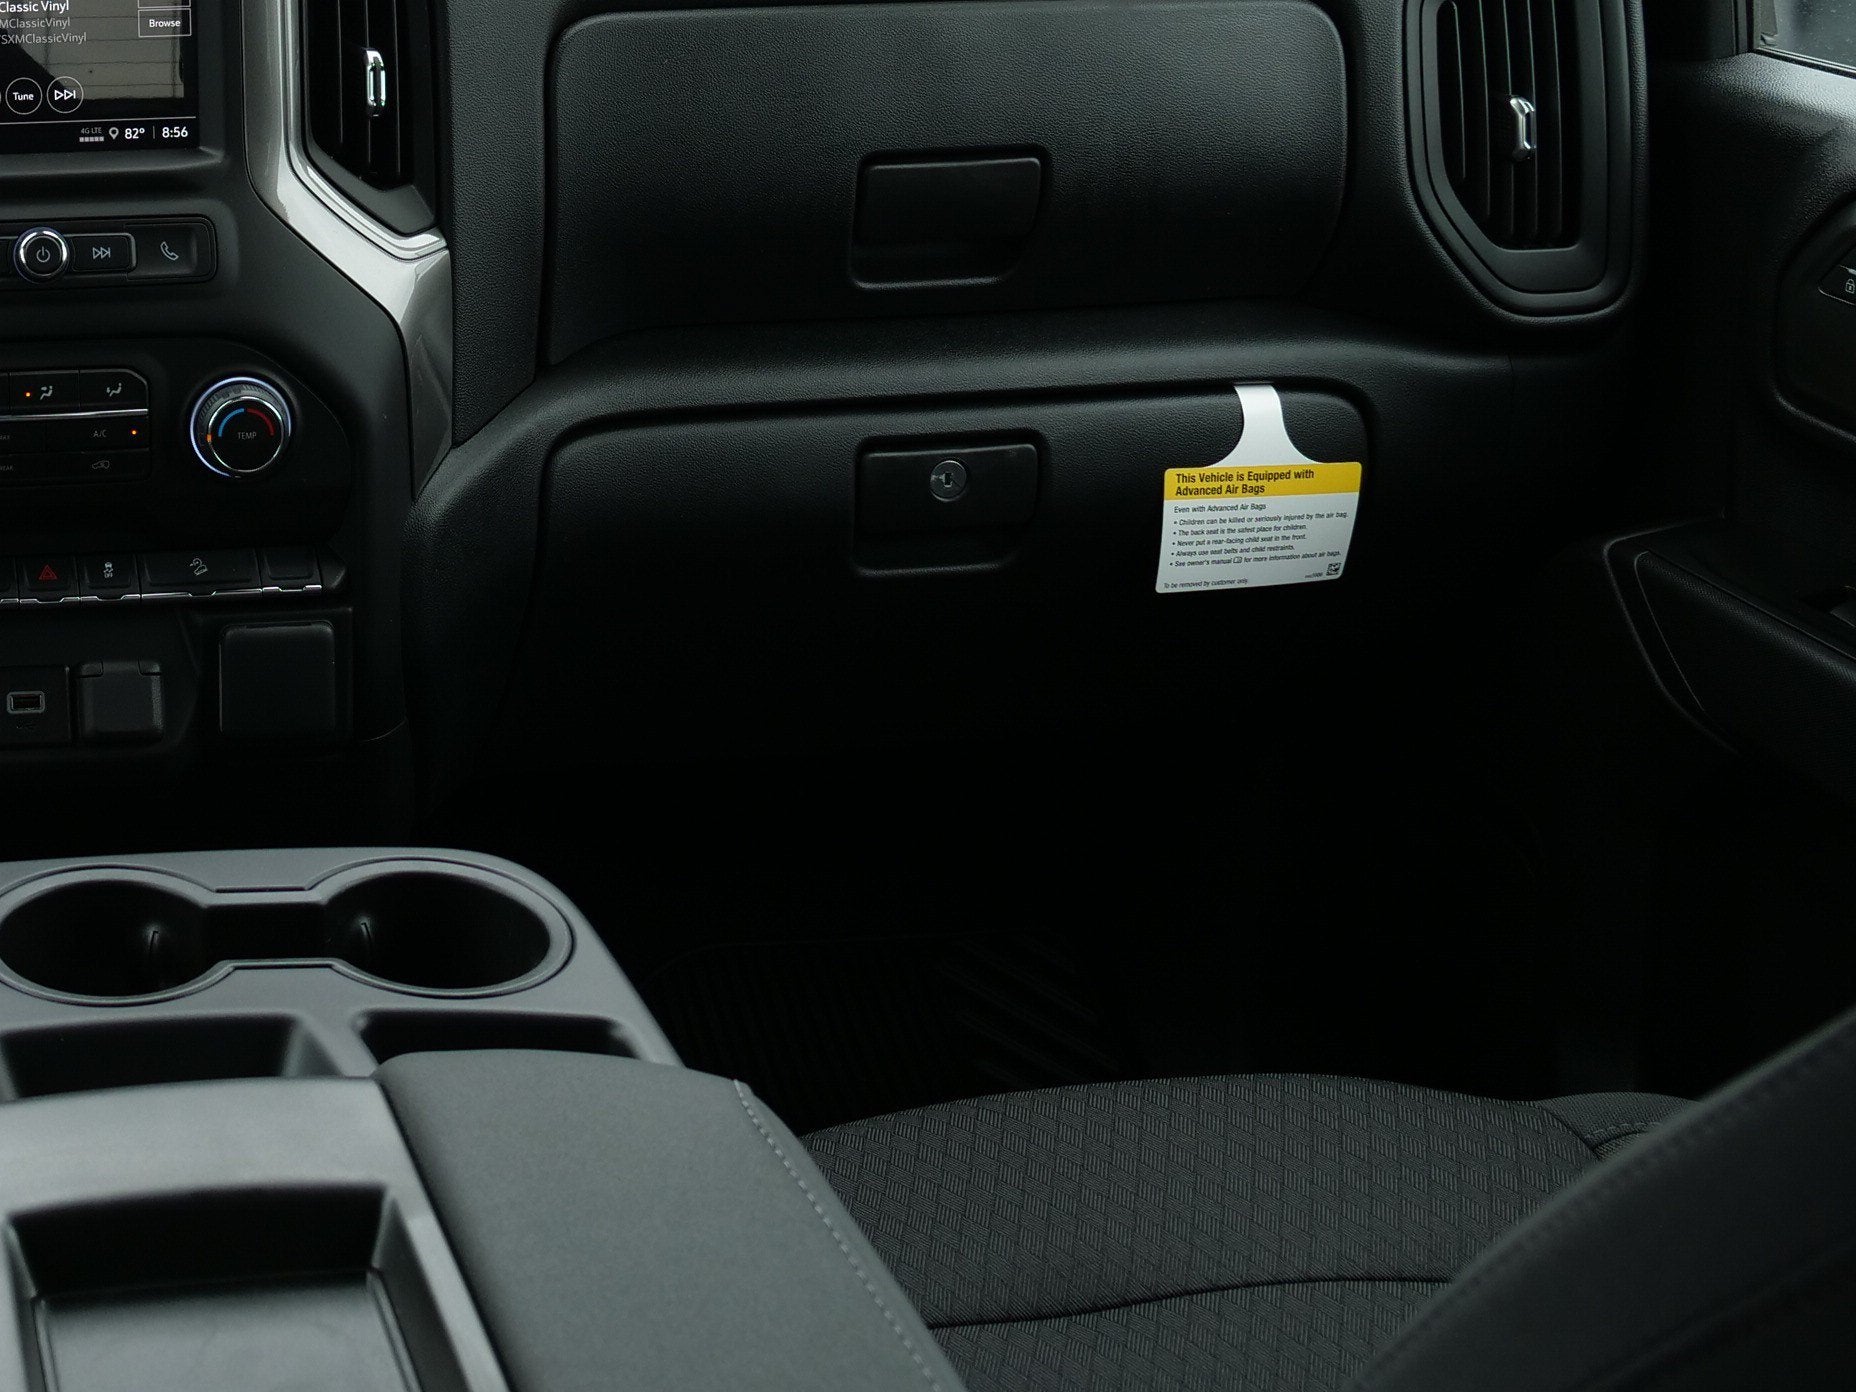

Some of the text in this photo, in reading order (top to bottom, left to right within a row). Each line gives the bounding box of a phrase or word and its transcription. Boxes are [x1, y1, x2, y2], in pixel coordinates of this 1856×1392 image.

[41, 0, 70, 14] Vinyl
[149, 18, 181, 29] Browse
[12, 92, 34, 102] Tune
[124, 128, 145, 140] 82°
[162, 127, 188, 140] 8:56
[93, 429, 107, 438] A/C
[237, 431, 257, 440] TEMP
[1176, 469, 1314, 483] This Vehicle is Equipped with
[1176, 483, 1265, 496] Advanced Air Bags
[1207, 504, 1238, 512] Advanced
[1240, 503, 1249, 511] Air
[1250, 503, 1266, 511] Bags
[1179, 518, 1205, 526] Children
[1254, 515, 1282, 523] seriously
